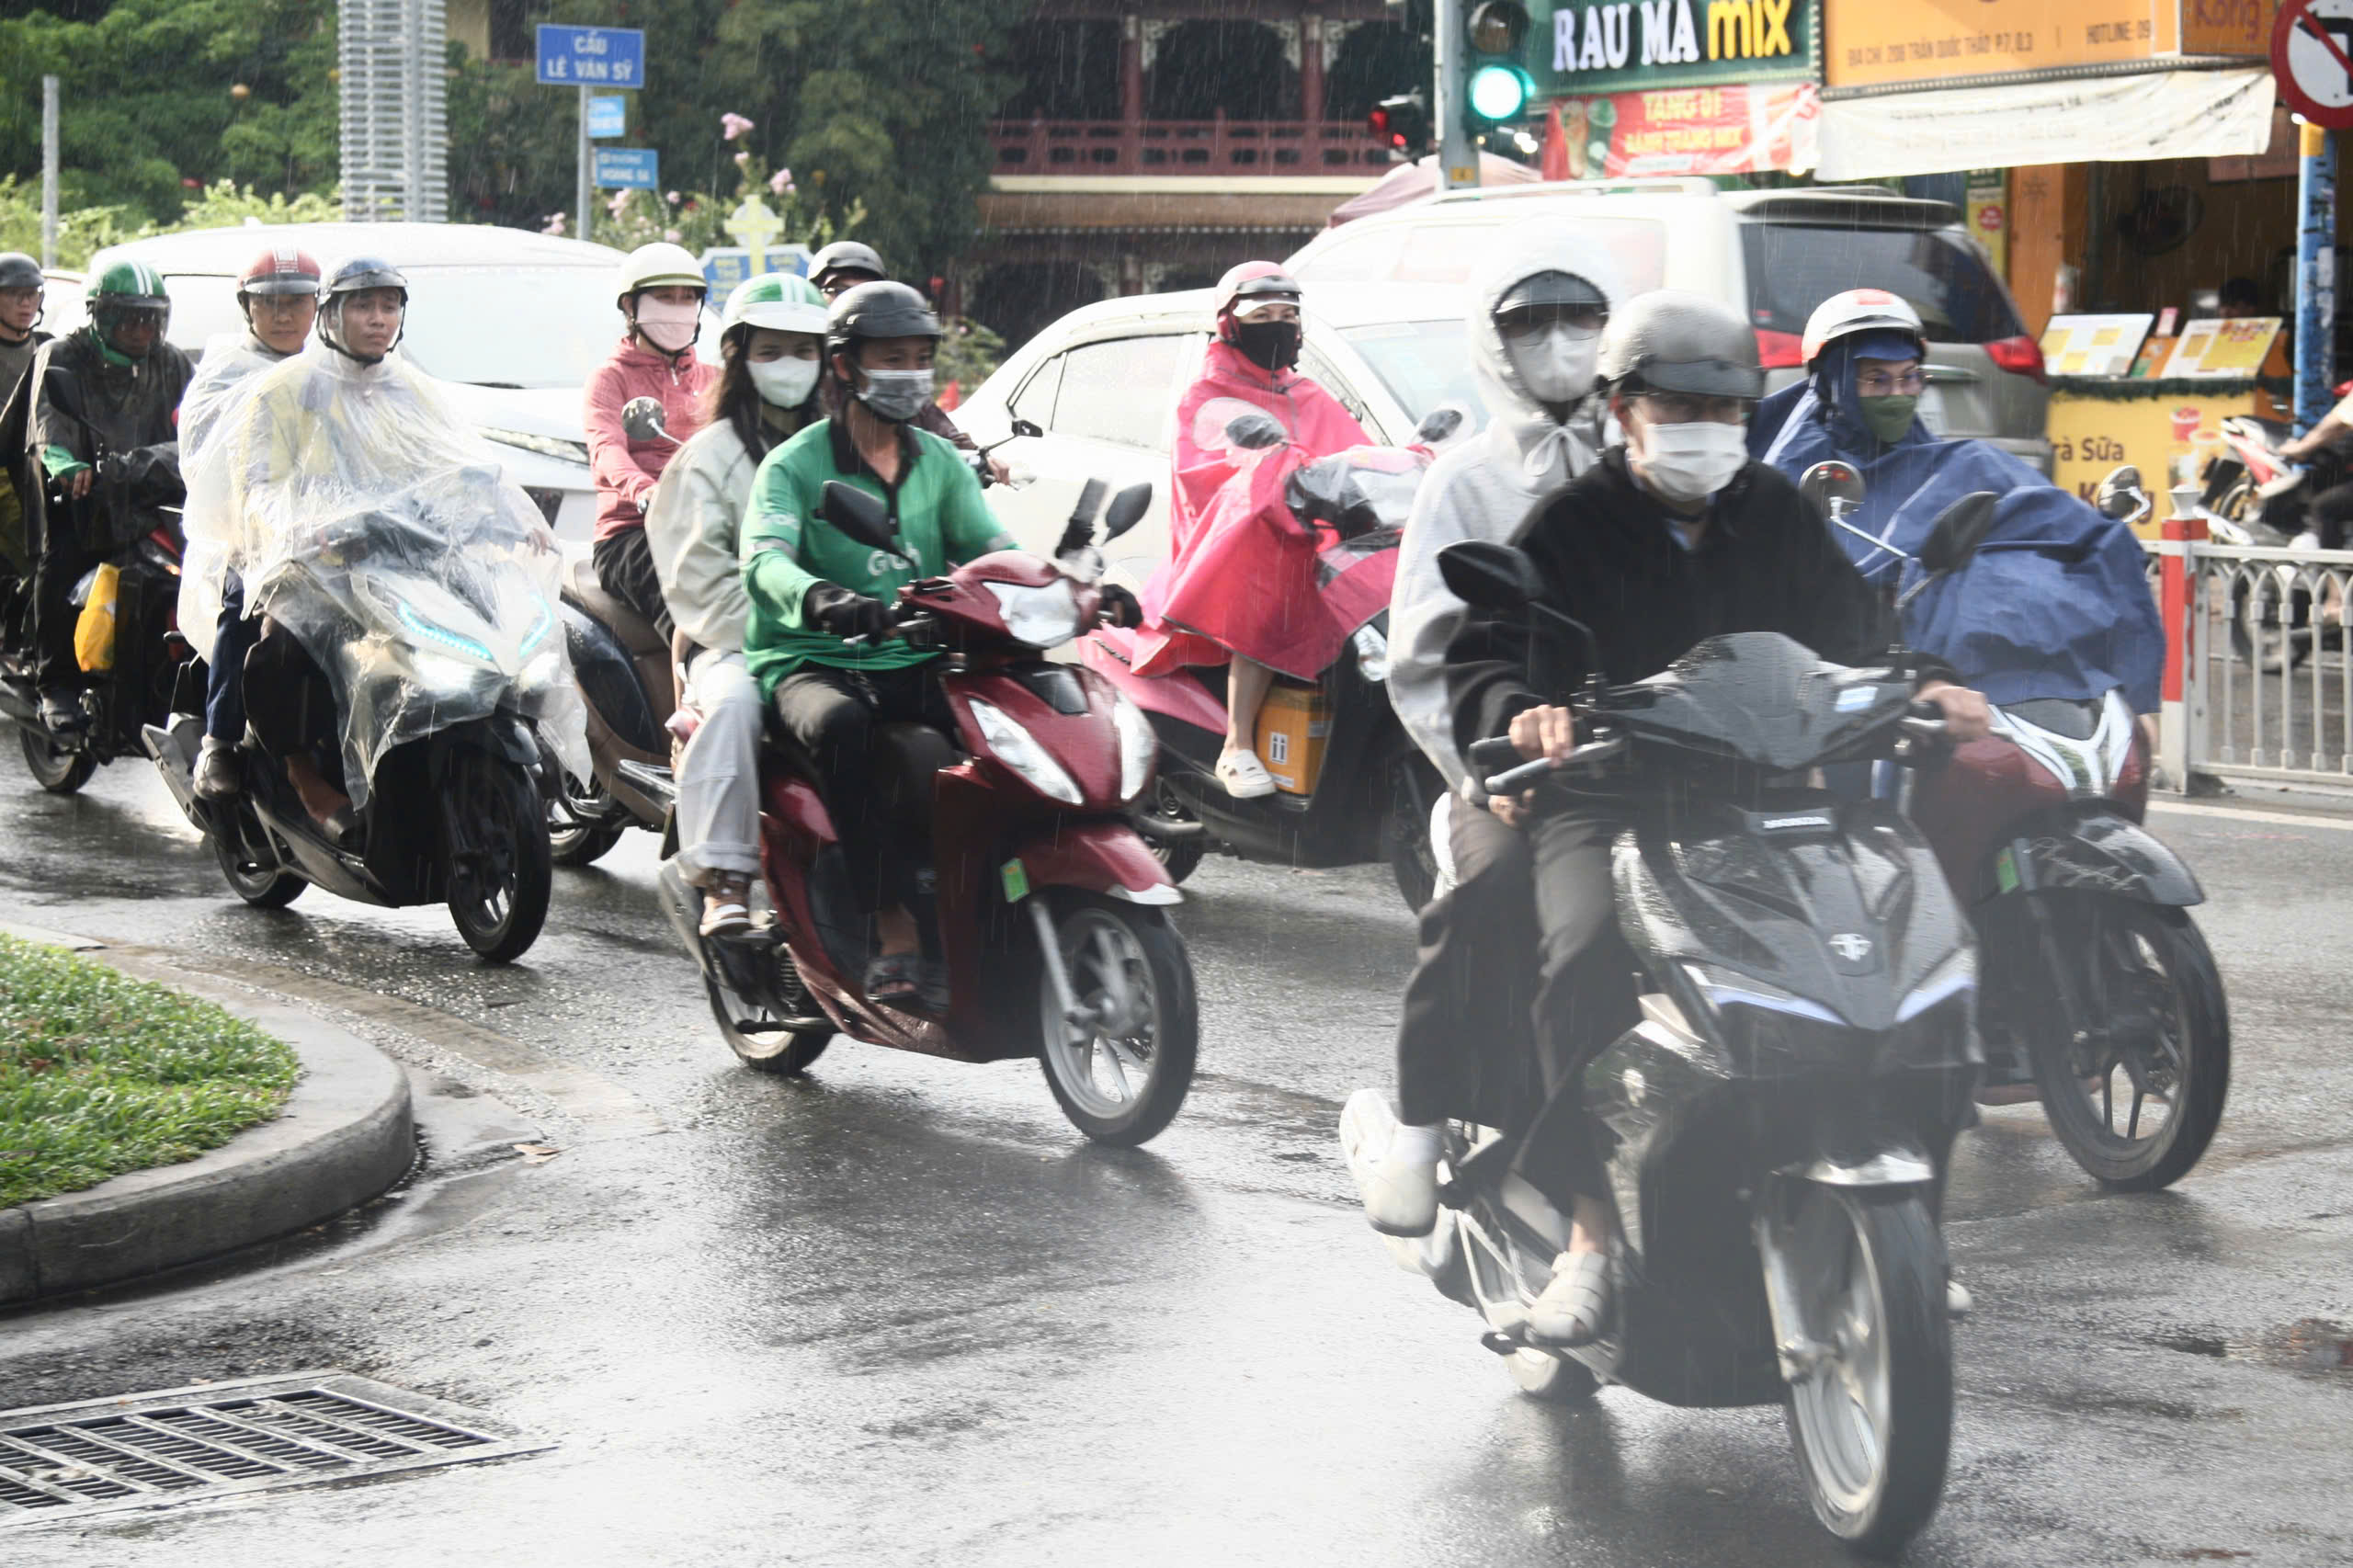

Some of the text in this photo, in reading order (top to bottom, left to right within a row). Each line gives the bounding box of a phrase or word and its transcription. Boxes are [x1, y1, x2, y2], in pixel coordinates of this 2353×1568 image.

[1552, 3, 1631, 73] RAU
[547, 55, 567, 78] LÊ
[574, 57, 608, 80] VĂN
[2046, 436, 2124, 461] rà Sữa
